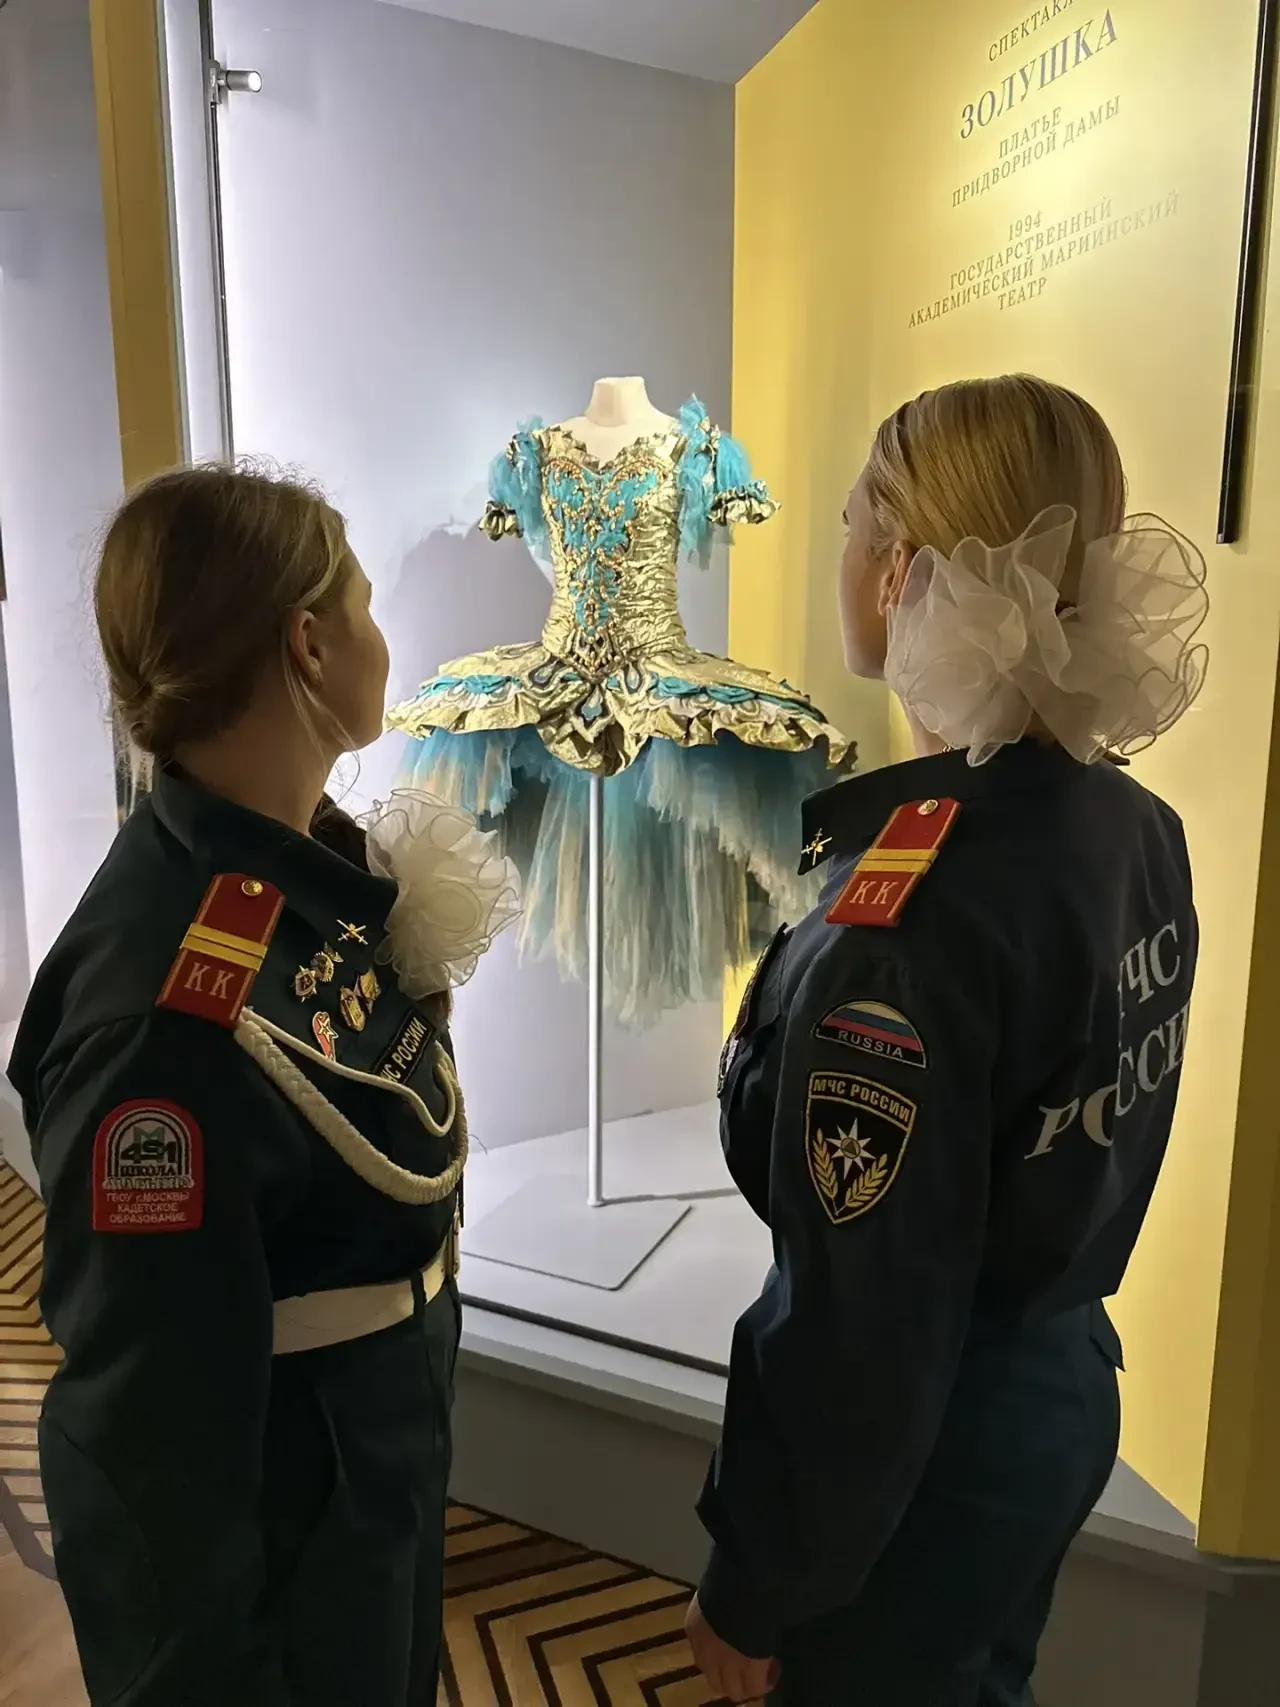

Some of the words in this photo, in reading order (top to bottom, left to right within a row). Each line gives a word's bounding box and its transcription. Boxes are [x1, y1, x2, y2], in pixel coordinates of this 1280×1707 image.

[960, 8, 1118, 139] ЗОЛУШКА
[952, 131, 1057, 207] ПРИДВОРНОЙ
[1063, 95, 1121, 148] ДАМЫ
[998, 106, 1062, 159] ПЛАТЬЕ
[908, 255, 1034, 328] АКАДЕМИЧЕСКИЙ
[1041, 189, 1179, 272] МАРИИНСКИЙ
[949, 196, 1112, 290] ГОСУДАРСТВЕННЫЙ
[1008, 209, 1044, 241] 1994
[997, 276, 1047, 311] ТЕАТР
[1117, 918, 1181, 1019] ЧС
[391, 1016, 428, 1070] РОССИИ
[838, 1030, 903, 1058] RUSSIA
[1024, 1000, 1191, 1159] РОССИ
[813, 1079, 846, 1095] МЧС
[850, 1083, 911, 1123] РОССИИ
